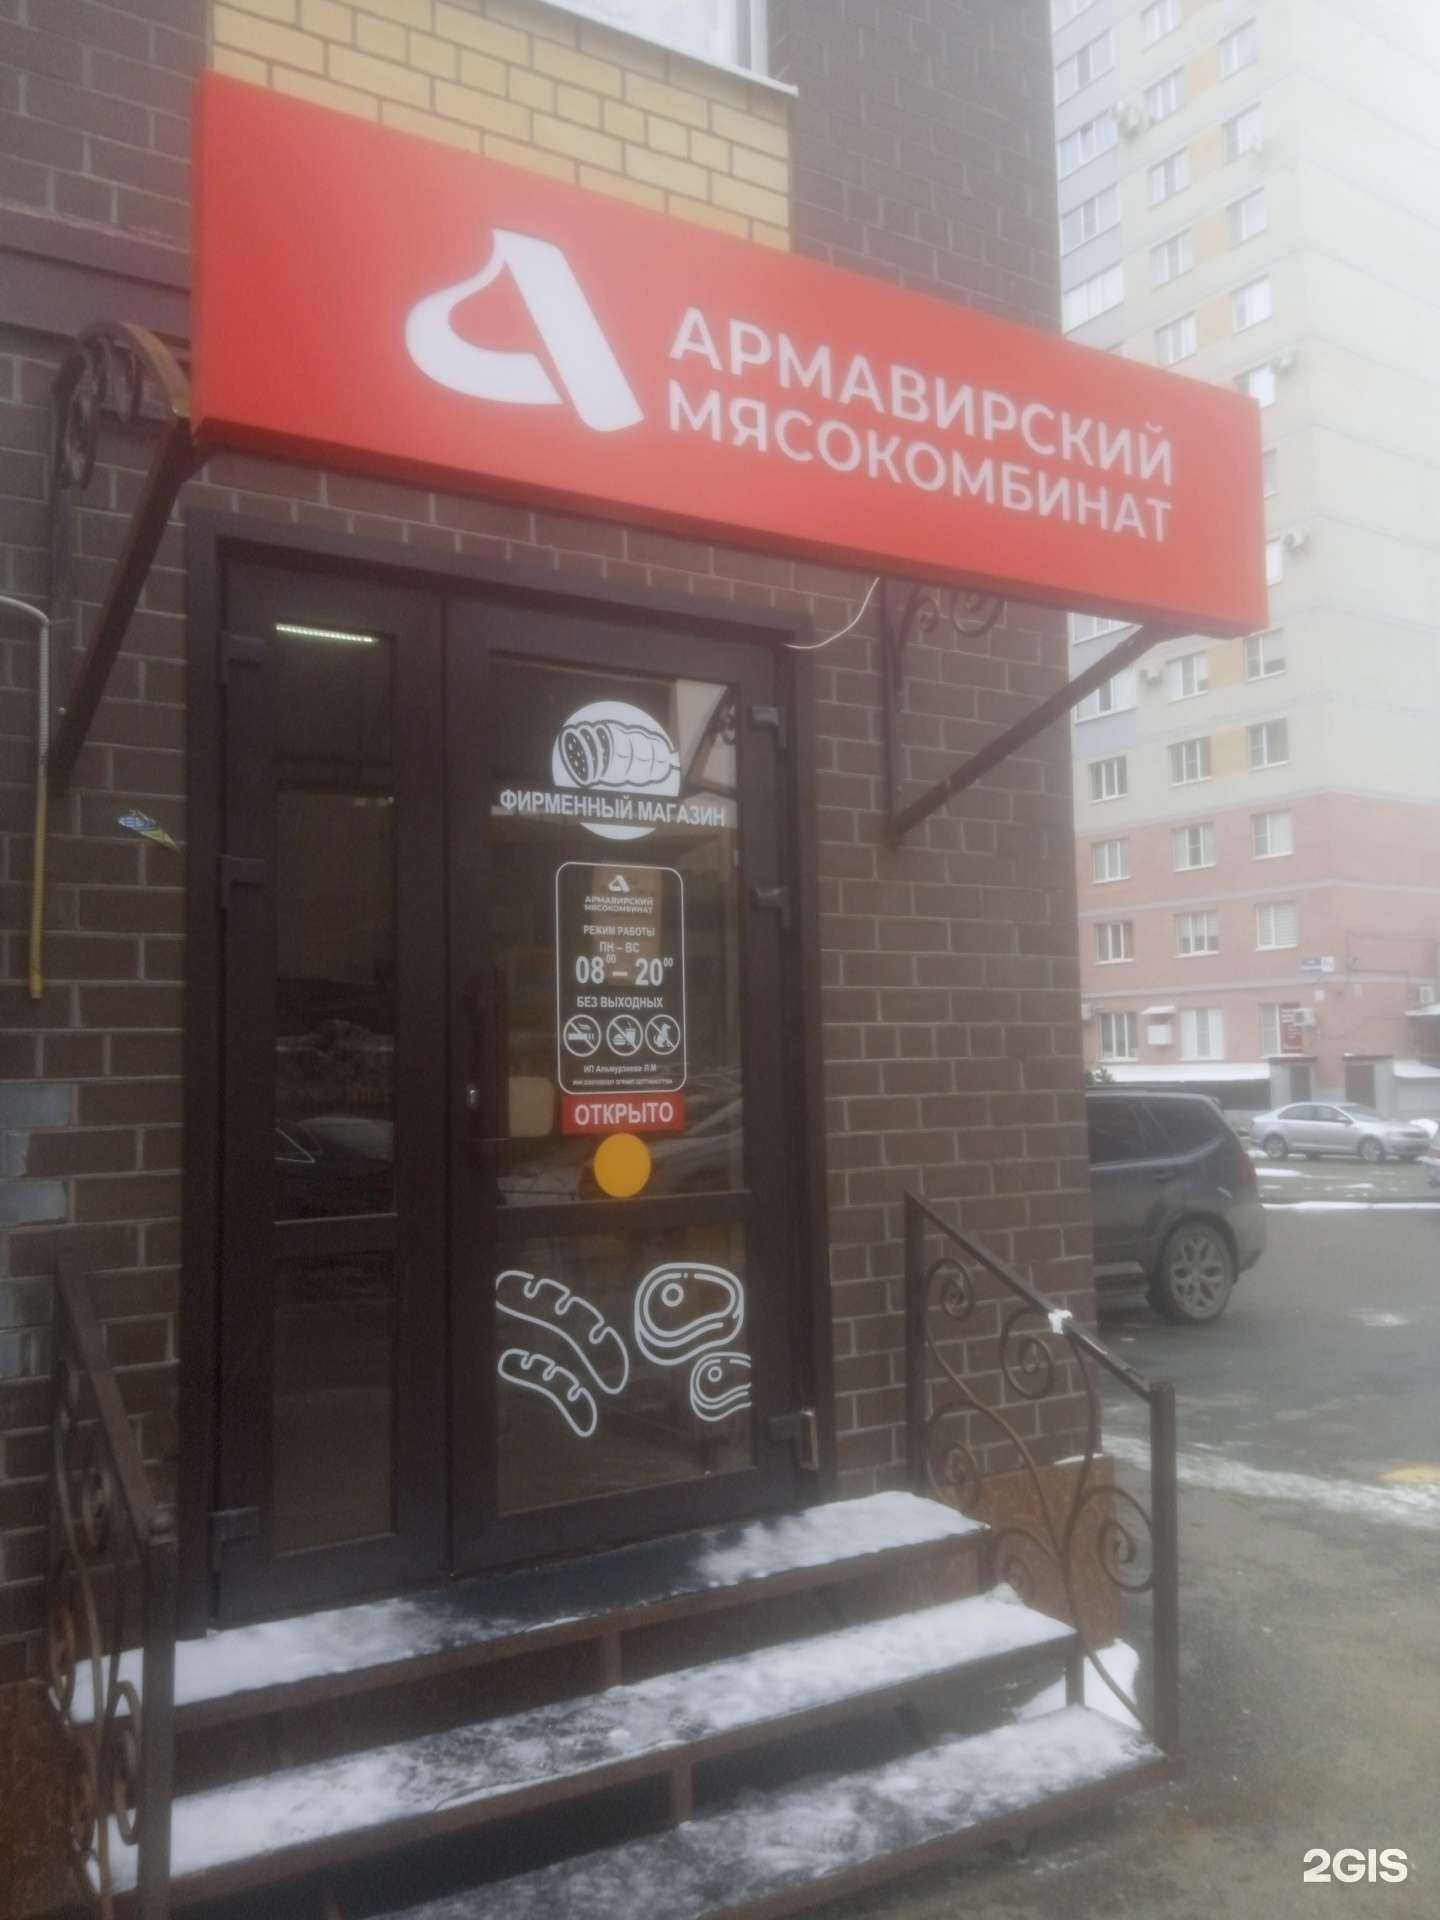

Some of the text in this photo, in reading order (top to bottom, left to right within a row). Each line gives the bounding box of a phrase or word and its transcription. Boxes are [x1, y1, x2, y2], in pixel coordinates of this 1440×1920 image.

[669, 305, 1173, 486] АРМАВИРСКИЙ
[667, 378, 1173, 543] МЯСОКОМБИНАТ
[499, 788, 726, 827] ФИРМЕННЫЙ МАГАЗИН
[583, 924, 656, 937] РЕЖИМ РАБОТЫ
[600, 941, 615, 953] ПН
[625, 942, 640, 953] ВС
[576, 996, 665, 1010] БЕЗ ВЫХОДНЫХ
[574, 1102, 674, 1126] ОТКРЫТО
